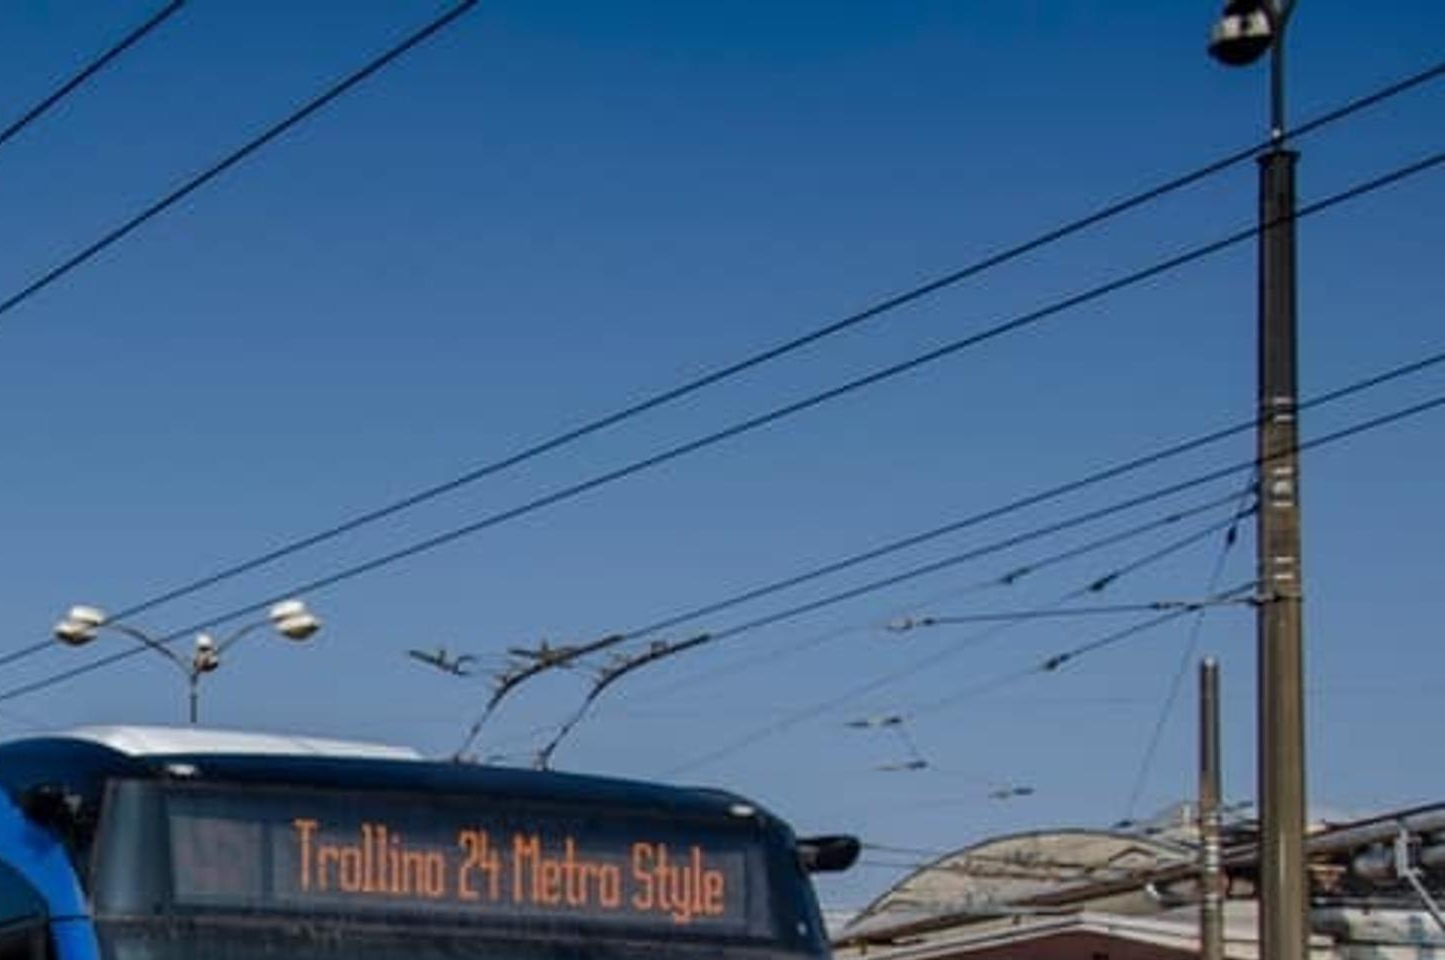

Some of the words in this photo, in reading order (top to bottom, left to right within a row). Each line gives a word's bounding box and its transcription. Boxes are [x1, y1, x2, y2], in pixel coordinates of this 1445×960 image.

[294, 818, 447, 898] Trollino
[457, 830, 502, 900] 24
[512, 834, 621, 907] Metro
[631, 842, 725, 924] Style
